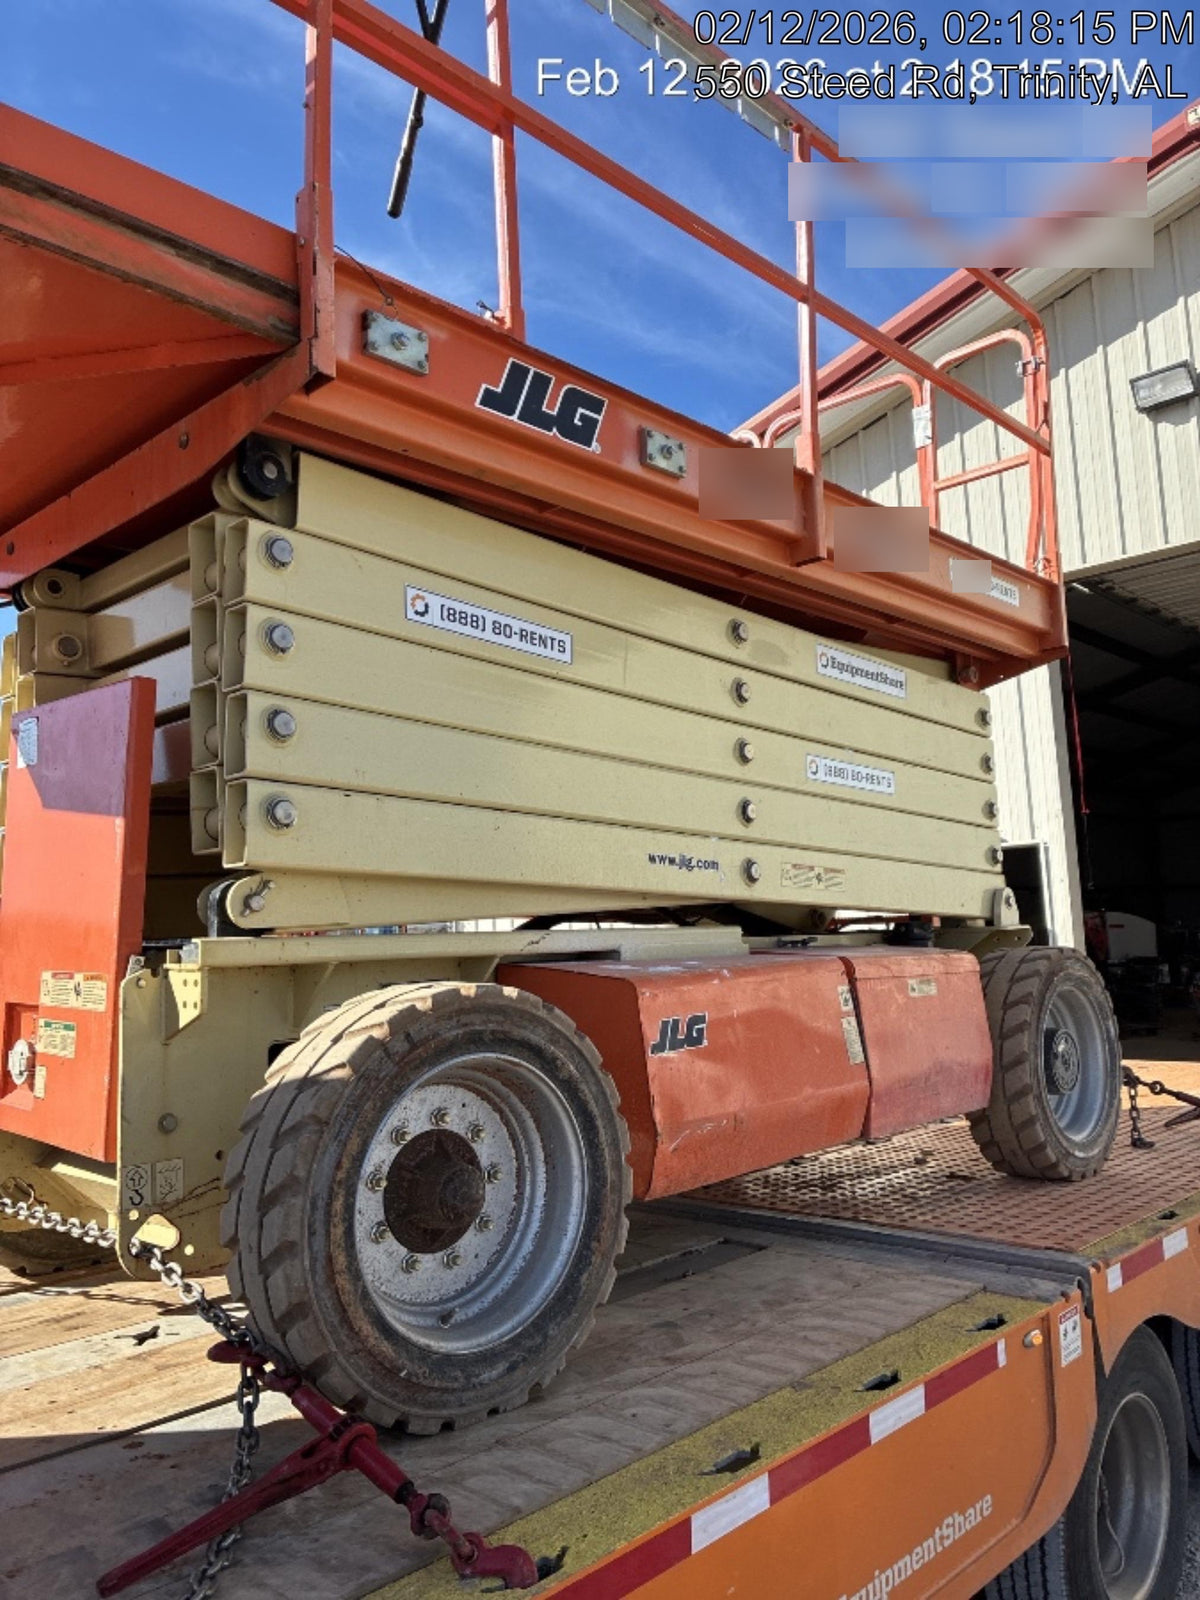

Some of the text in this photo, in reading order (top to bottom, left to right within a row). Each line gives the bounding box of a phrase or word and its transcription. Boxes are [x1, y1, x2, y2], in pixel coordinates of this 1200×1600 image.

[475, 357, 609, 454] JLG
[439, 603, 567, 654] (888) 80-RENTS
[829, 655, 905, 691] EquipmentShare
[649, 1011, 709, 1057] JLG
[838, 1494, 993, 1600] uipmentShare
